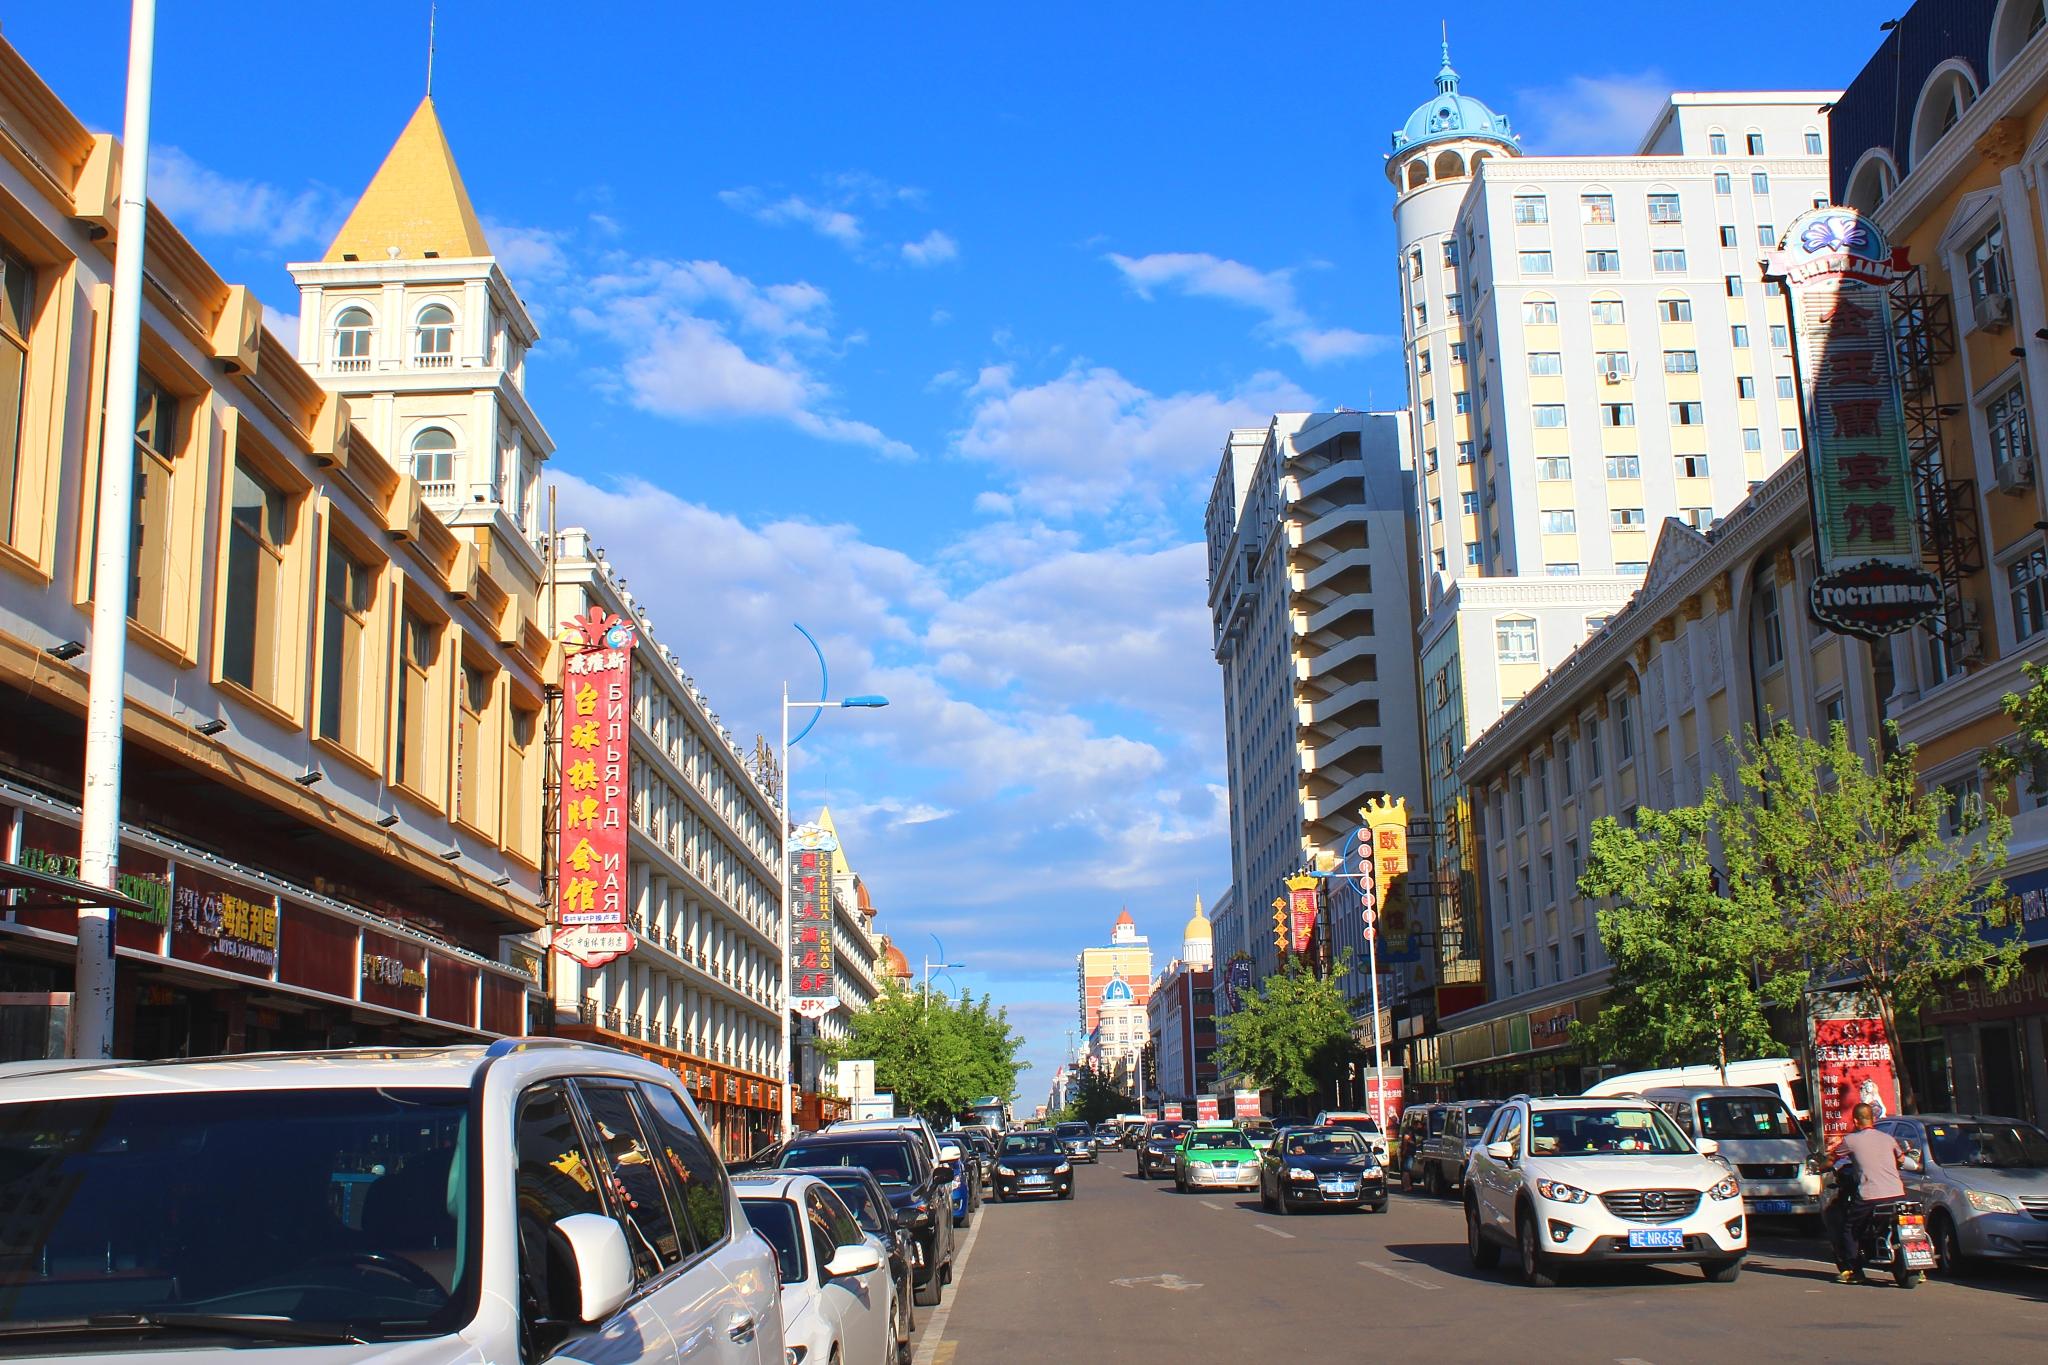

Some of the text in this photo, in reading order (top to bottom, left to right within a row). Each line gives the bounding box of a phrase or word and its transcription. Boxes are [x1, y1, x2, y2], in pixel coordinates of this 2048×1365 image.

[563, 682, 602, 913] 台球棋牌会馆
[1647, 1231, 1681, 1245] NR656
